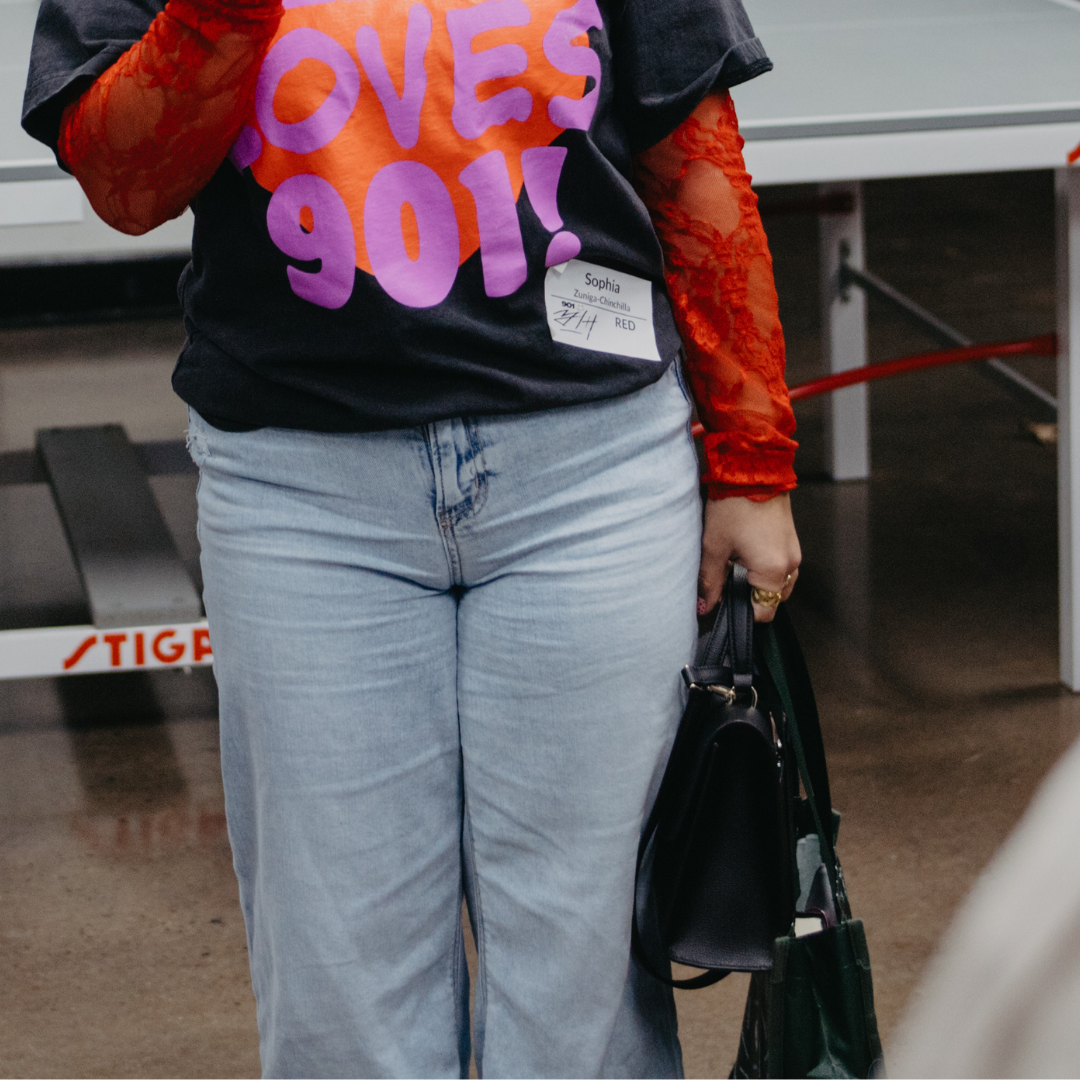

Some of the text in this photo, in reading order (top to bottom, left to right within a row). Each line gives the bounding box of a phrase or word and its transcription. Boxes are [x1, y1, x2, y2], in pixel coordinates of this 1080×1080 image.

[267, 146, 582, 309] 901!
[585, 272, 620, 294] Sophia
[561, 300, 576, 310] 901
[573, 289, 631, 312] Zuniga-Chinchilla
[615, 317, 636, 331] RED
